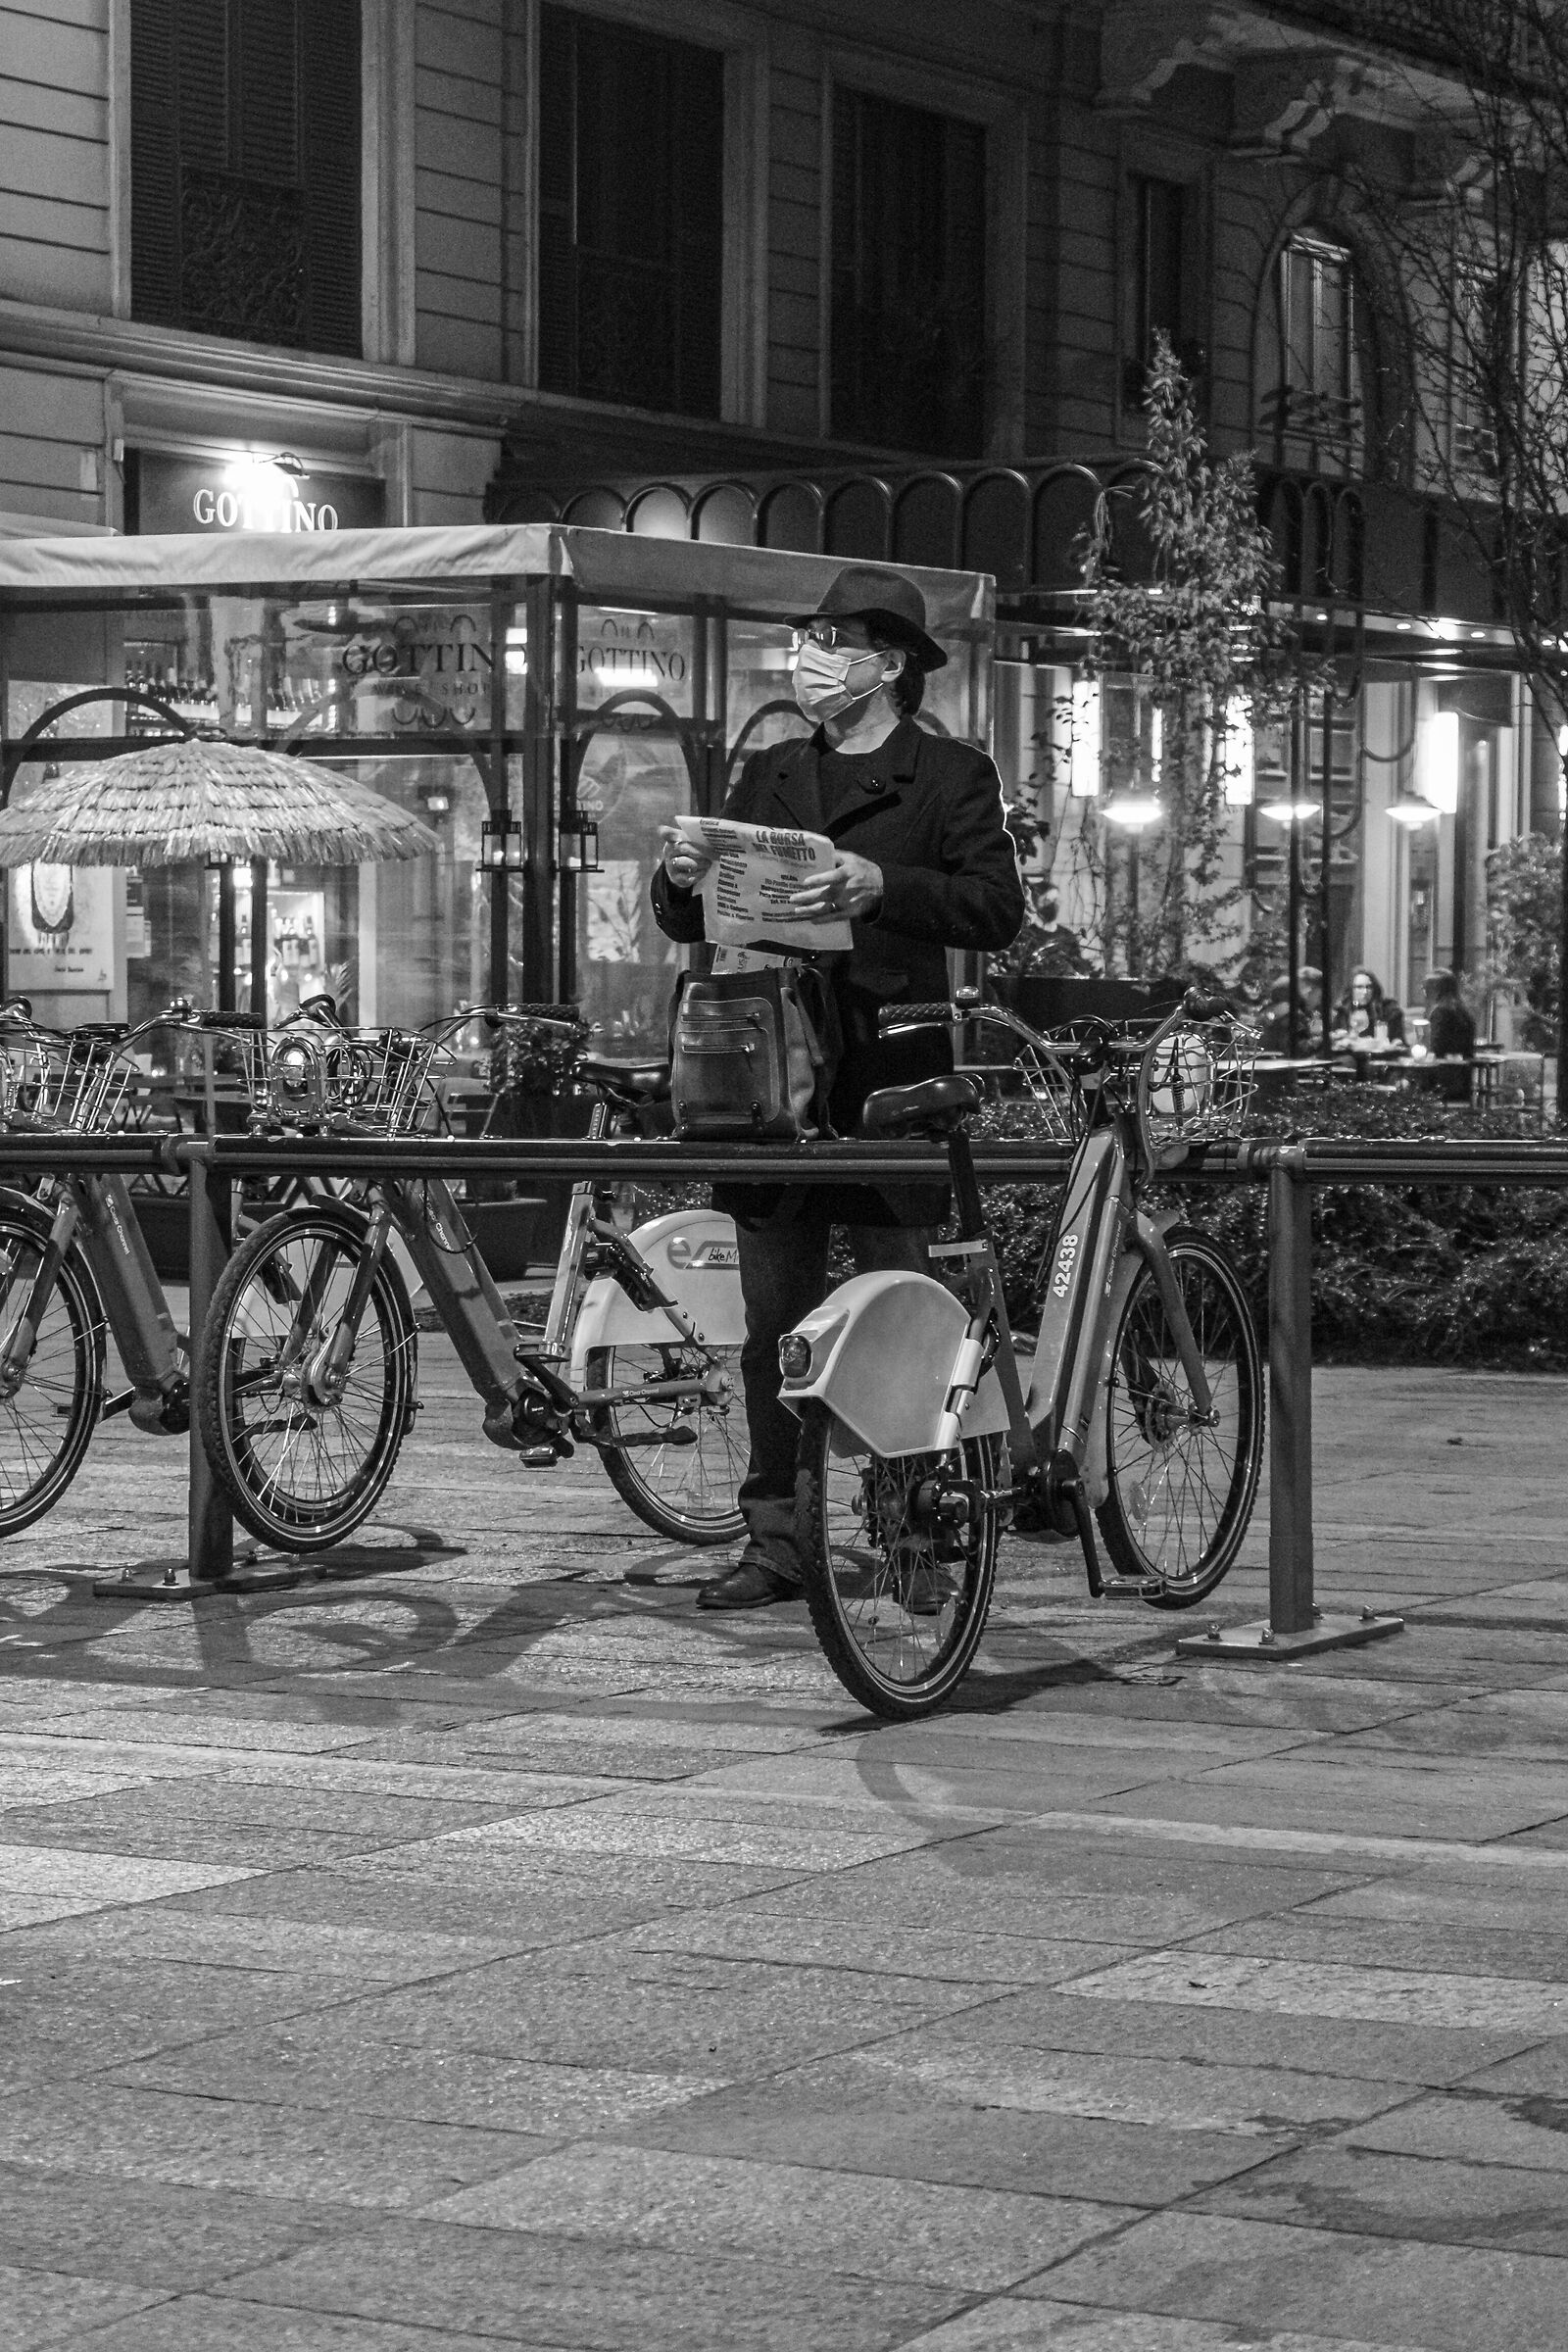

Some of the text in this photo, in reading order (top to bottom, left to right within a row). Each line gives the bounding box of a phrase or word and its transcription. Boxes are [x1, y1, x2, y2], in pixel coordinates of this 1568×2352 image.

[193, 489, 338, 533] GOTTINO
[757, 831, 807, 847] LA BORSA
[1053, 1235, 1079, 1298] 42438
